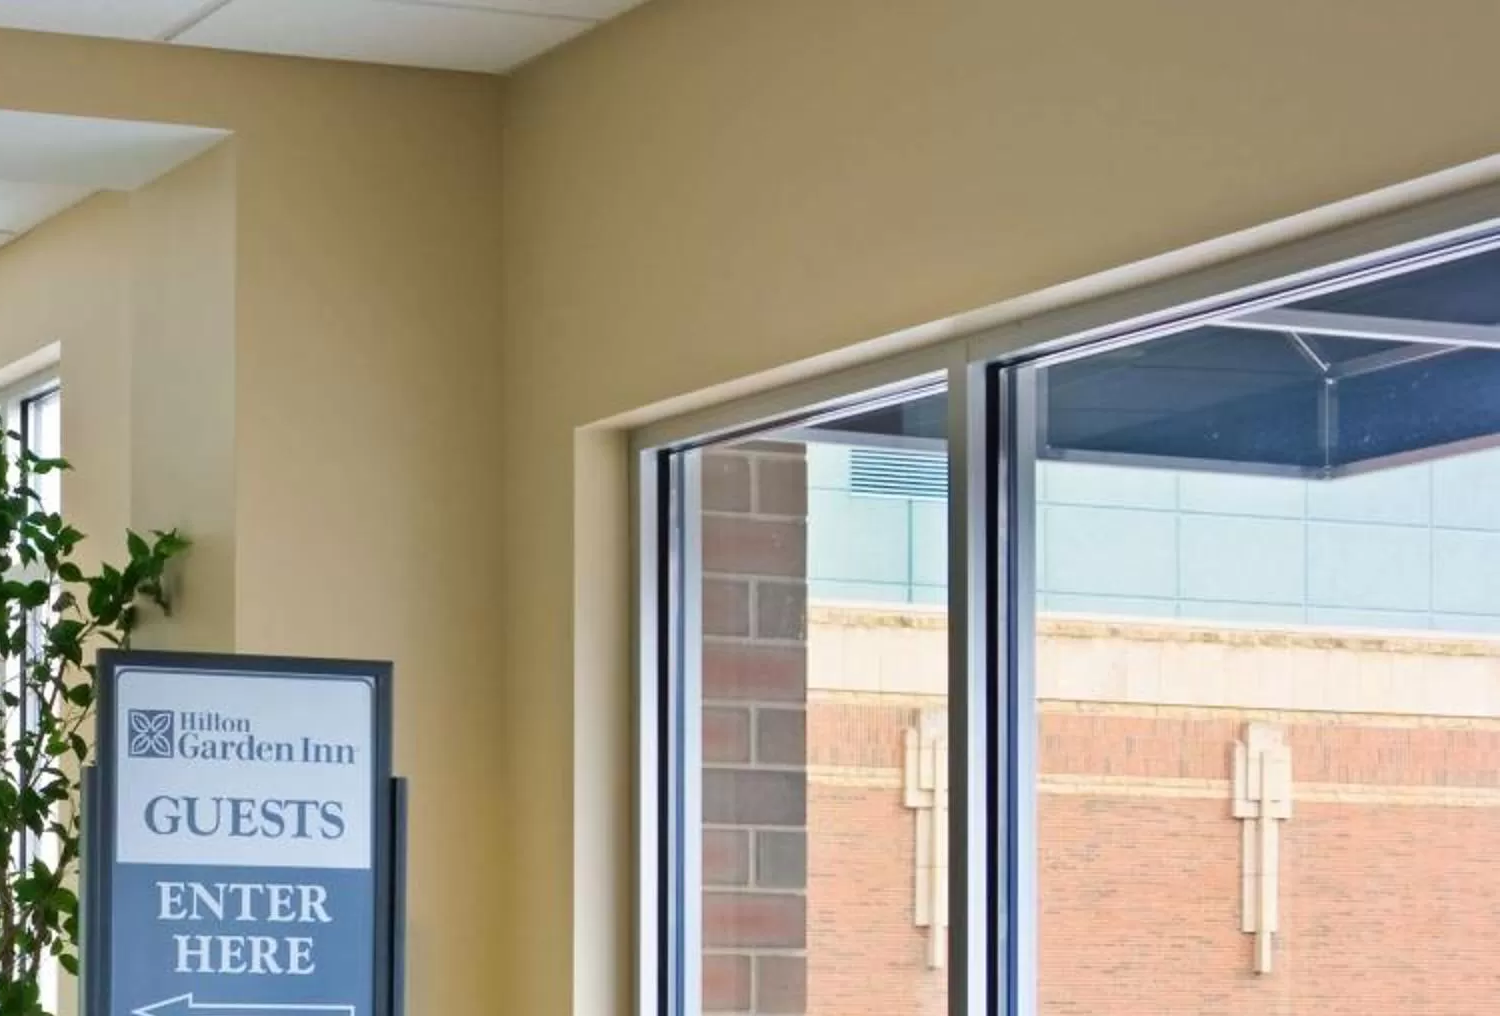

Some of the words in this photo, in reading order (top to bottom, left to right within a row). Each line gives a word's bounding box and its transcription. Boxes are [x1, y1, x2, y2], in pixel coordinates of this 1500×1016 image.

[180, 711, 250, 733] Hilton
[178, 732, 294, 762] Garden
[300, 737, 355, 765] Inn
[144, 794, 345, 840] GUESTS
[156, 881, 332, 923] ENTER
[173, 934, 315, 975] HERE
